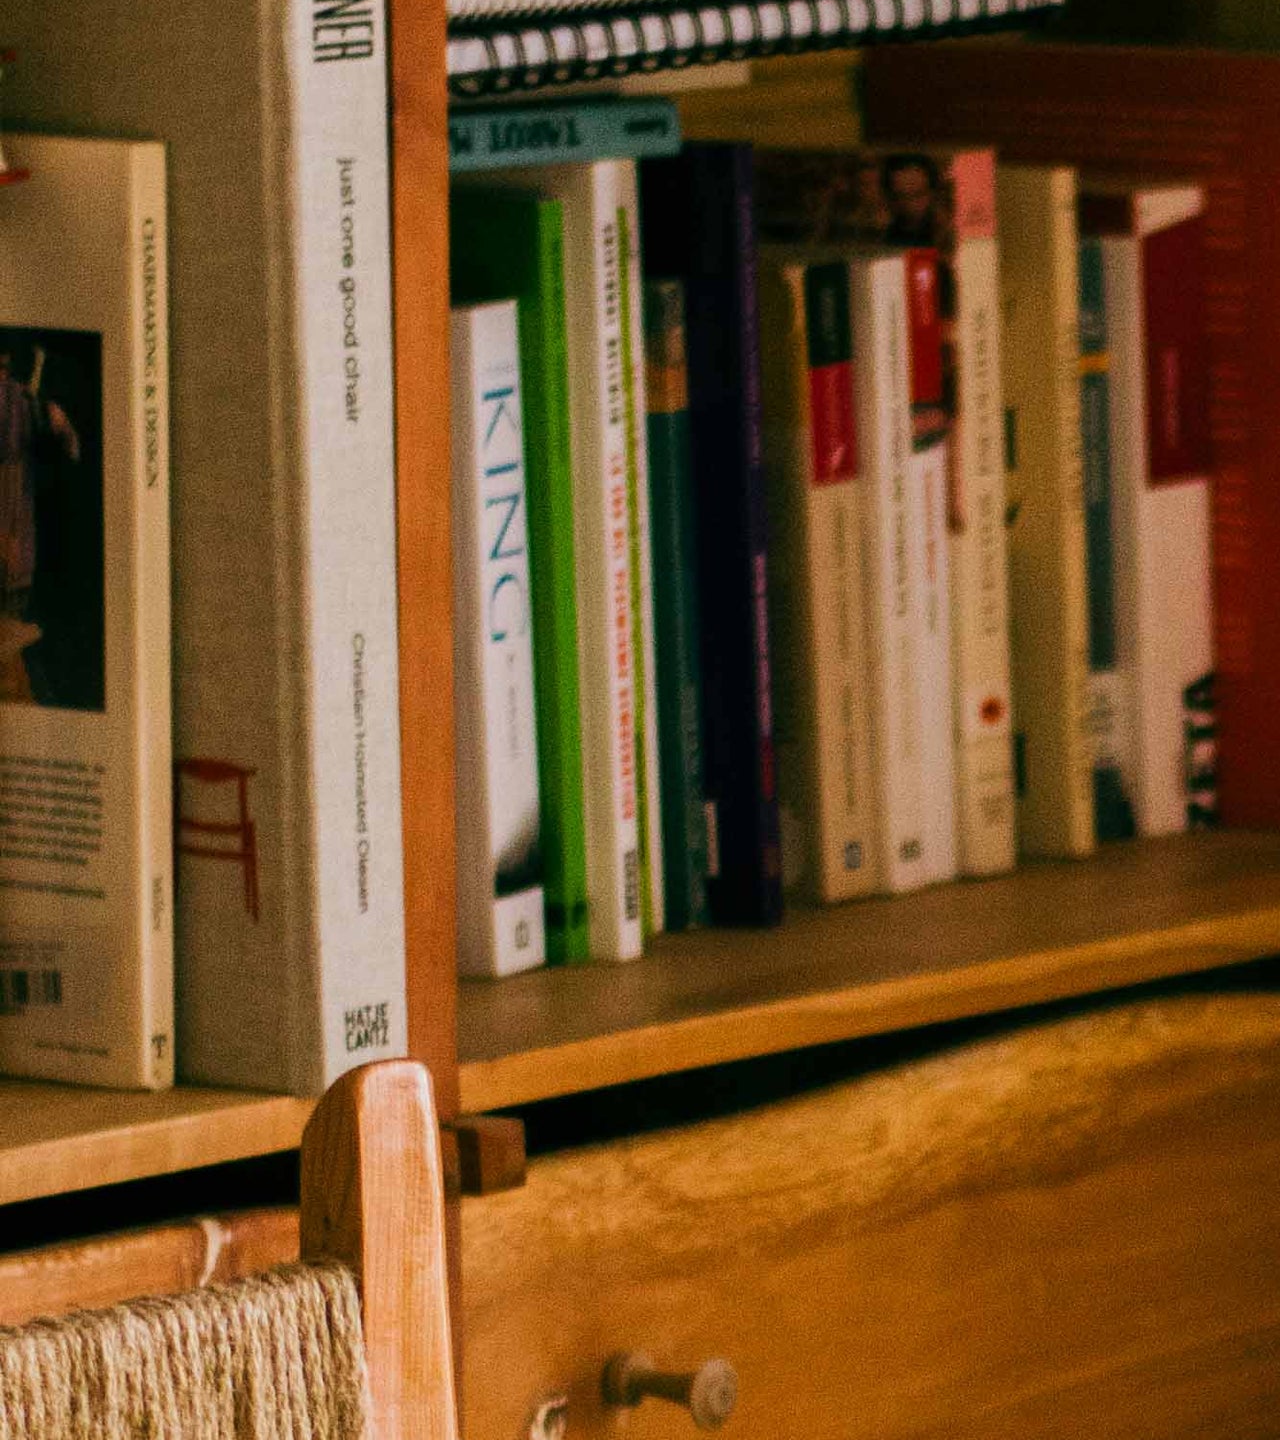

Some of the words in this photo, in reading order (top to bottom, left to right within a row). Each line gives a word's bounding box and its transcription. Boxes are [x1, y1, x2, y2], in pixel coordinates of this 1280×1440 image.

[337, 157, 356, 206] just
[342, 215, 355, 269] one
[143, 216, 158, 377] CHAIRMAKING
[340, 276, 359, 349] good
[145, 385, 157, 400] &
[344, 356, 360, 424] chair
[482, 387, 529, 643] KING
[351, 632, 366, 727] Christian
[343, 1002, 389, 1030] HATJE
[344, 1020, 390, 1053] CANTZ
